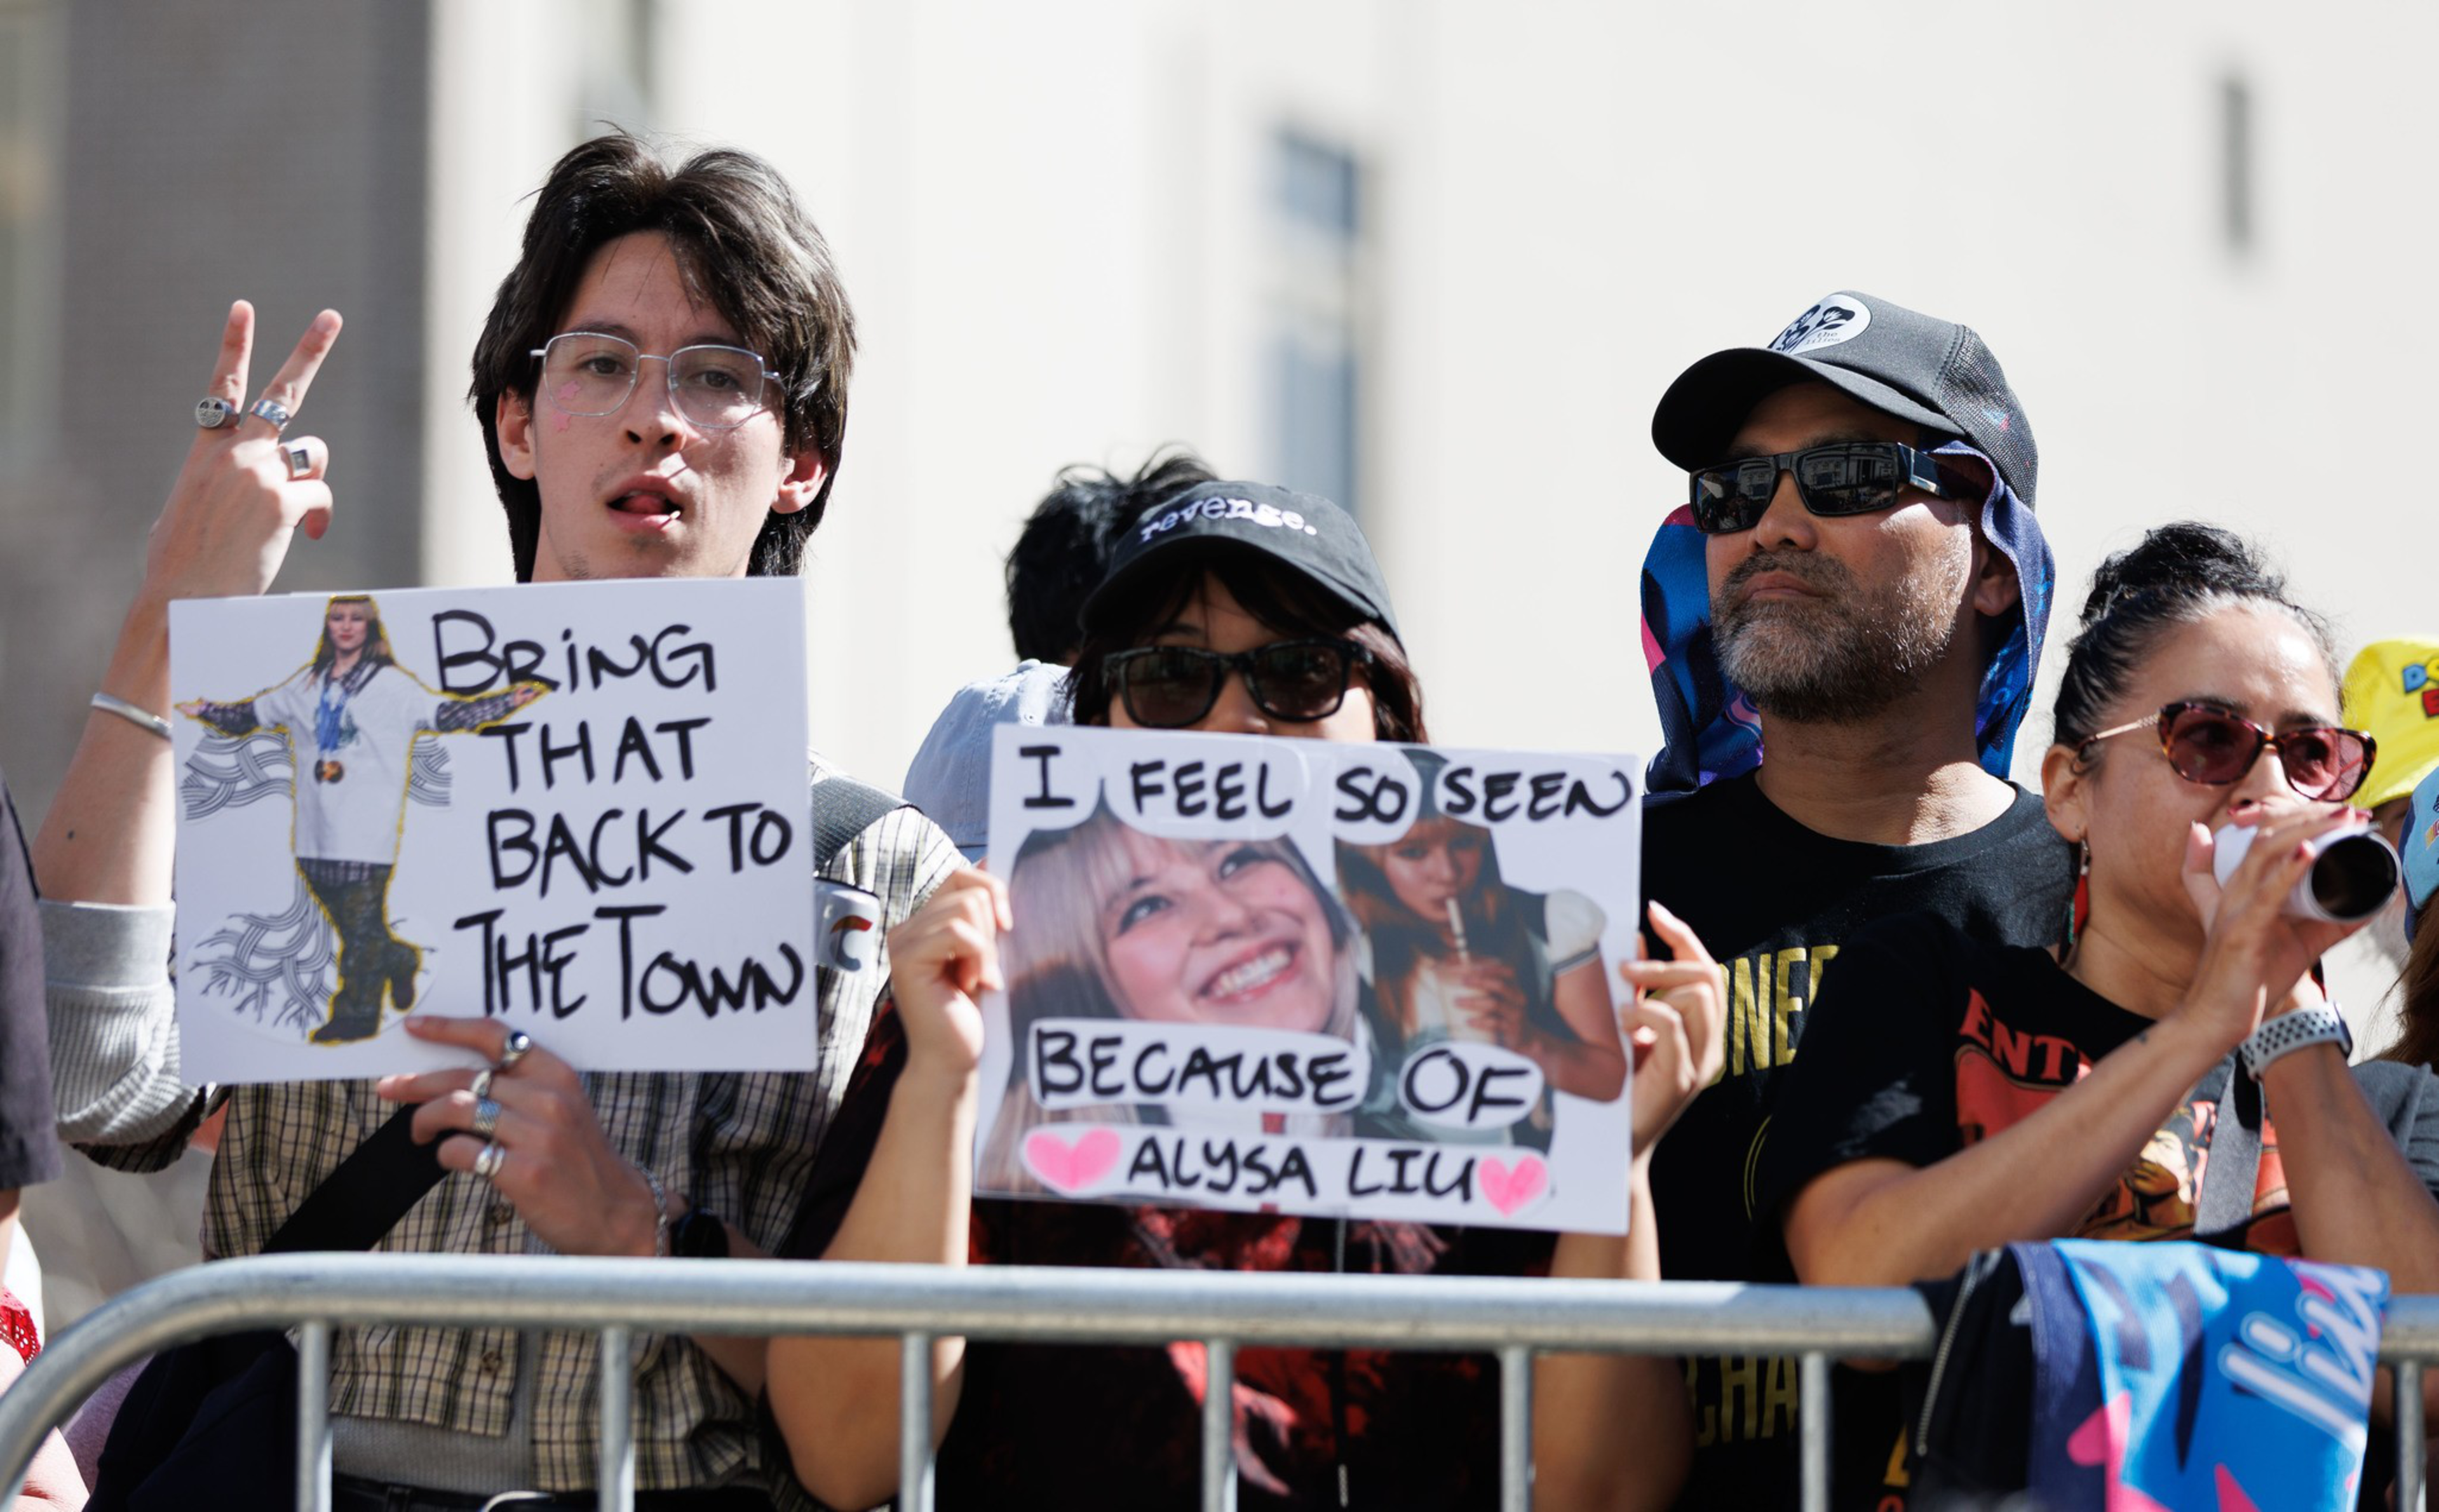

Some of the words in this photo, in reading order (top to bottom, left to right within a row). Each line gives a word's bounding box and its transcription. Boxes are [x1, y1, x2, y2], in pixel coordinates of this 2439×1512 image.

[1140, 496, 1318, 542] revenge.
[478, 717, 712, 792] THAT
[1019, 745, 1076, 809] I
[1130, 760, 1292, 820] FEEL
[1335, 766, 1408, 824] SO
[1444, 767, 1632, 823] SEEN
[487, 808, 694, 897] BACK
[703, 802, 792, 872] TO
[454, 909, 589, 1020] THE
[1036, 1028, 1355, 1100] BECAUSE
[1403, 1050, 1531, 1123] OF
